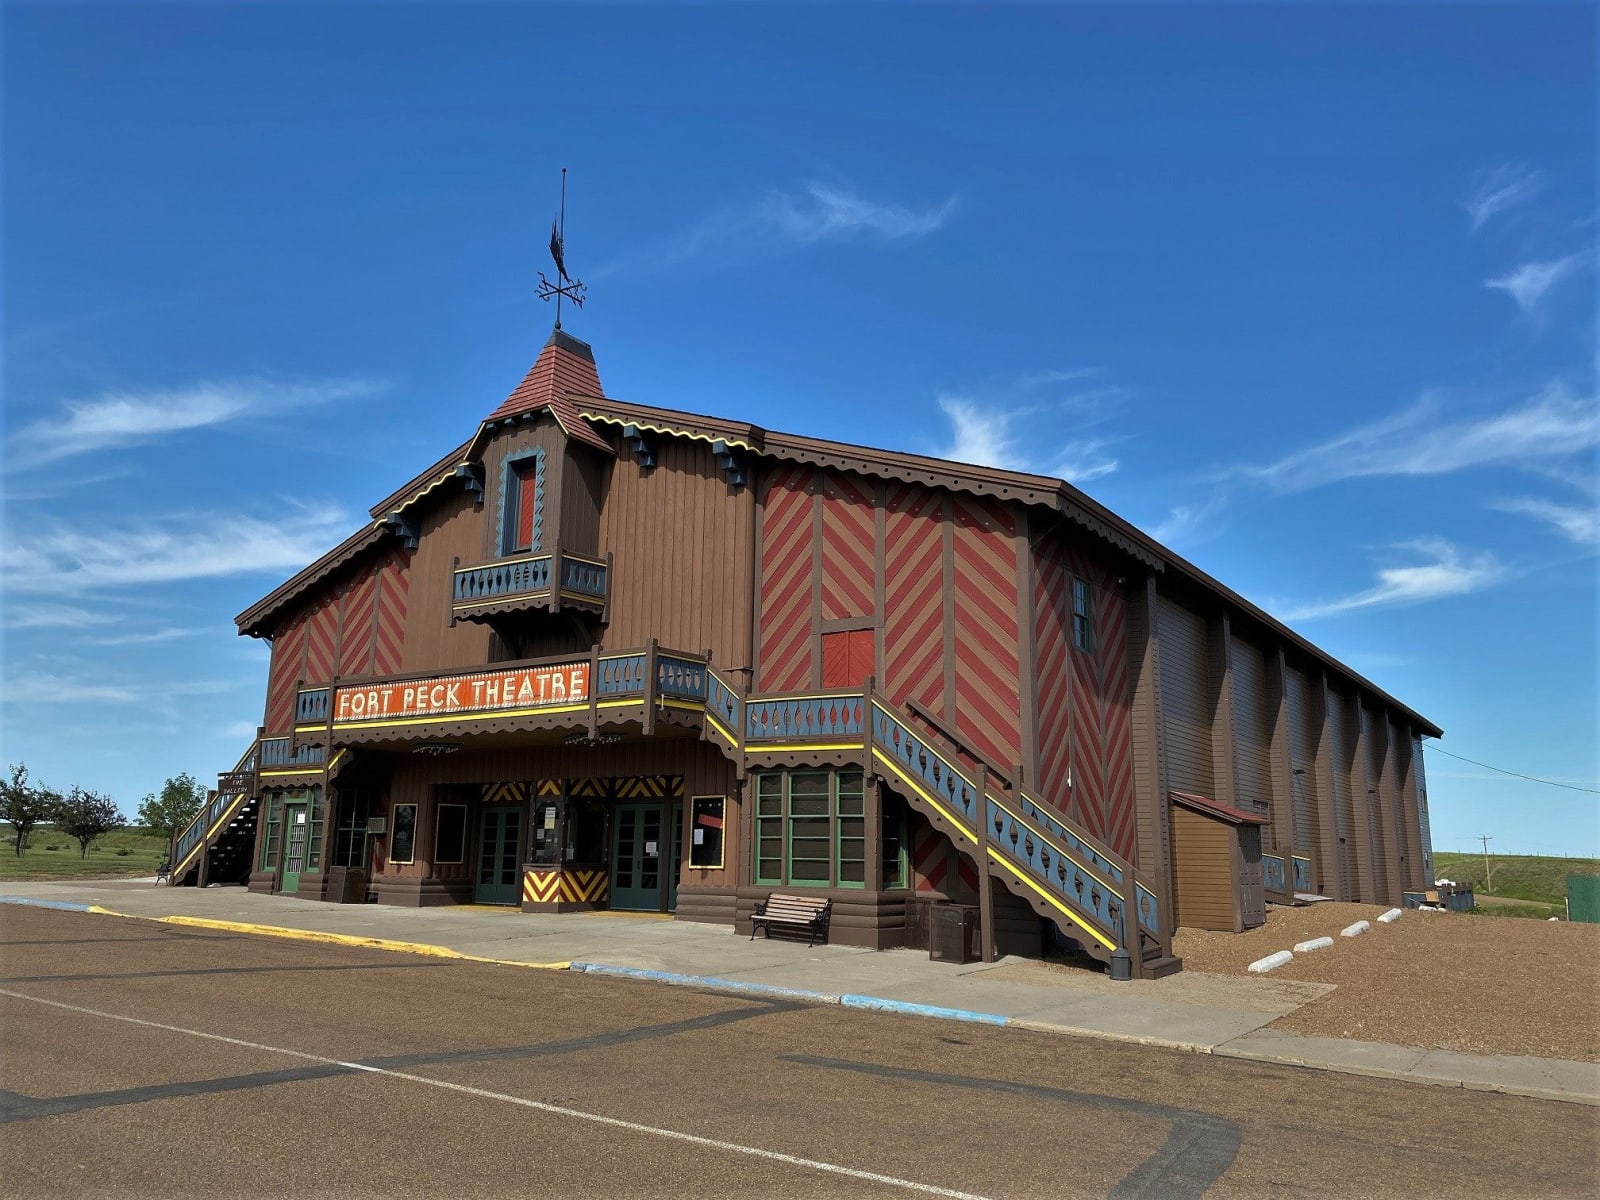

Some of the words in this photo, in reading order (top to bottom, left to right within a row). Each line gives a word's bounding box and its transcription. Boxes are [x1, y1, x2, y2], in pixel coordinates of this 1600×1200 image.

[339, 689, 392, 715] FORT
[403, 682, 461, 709] PECK
[471, 670, 583, 704] THEATRE
